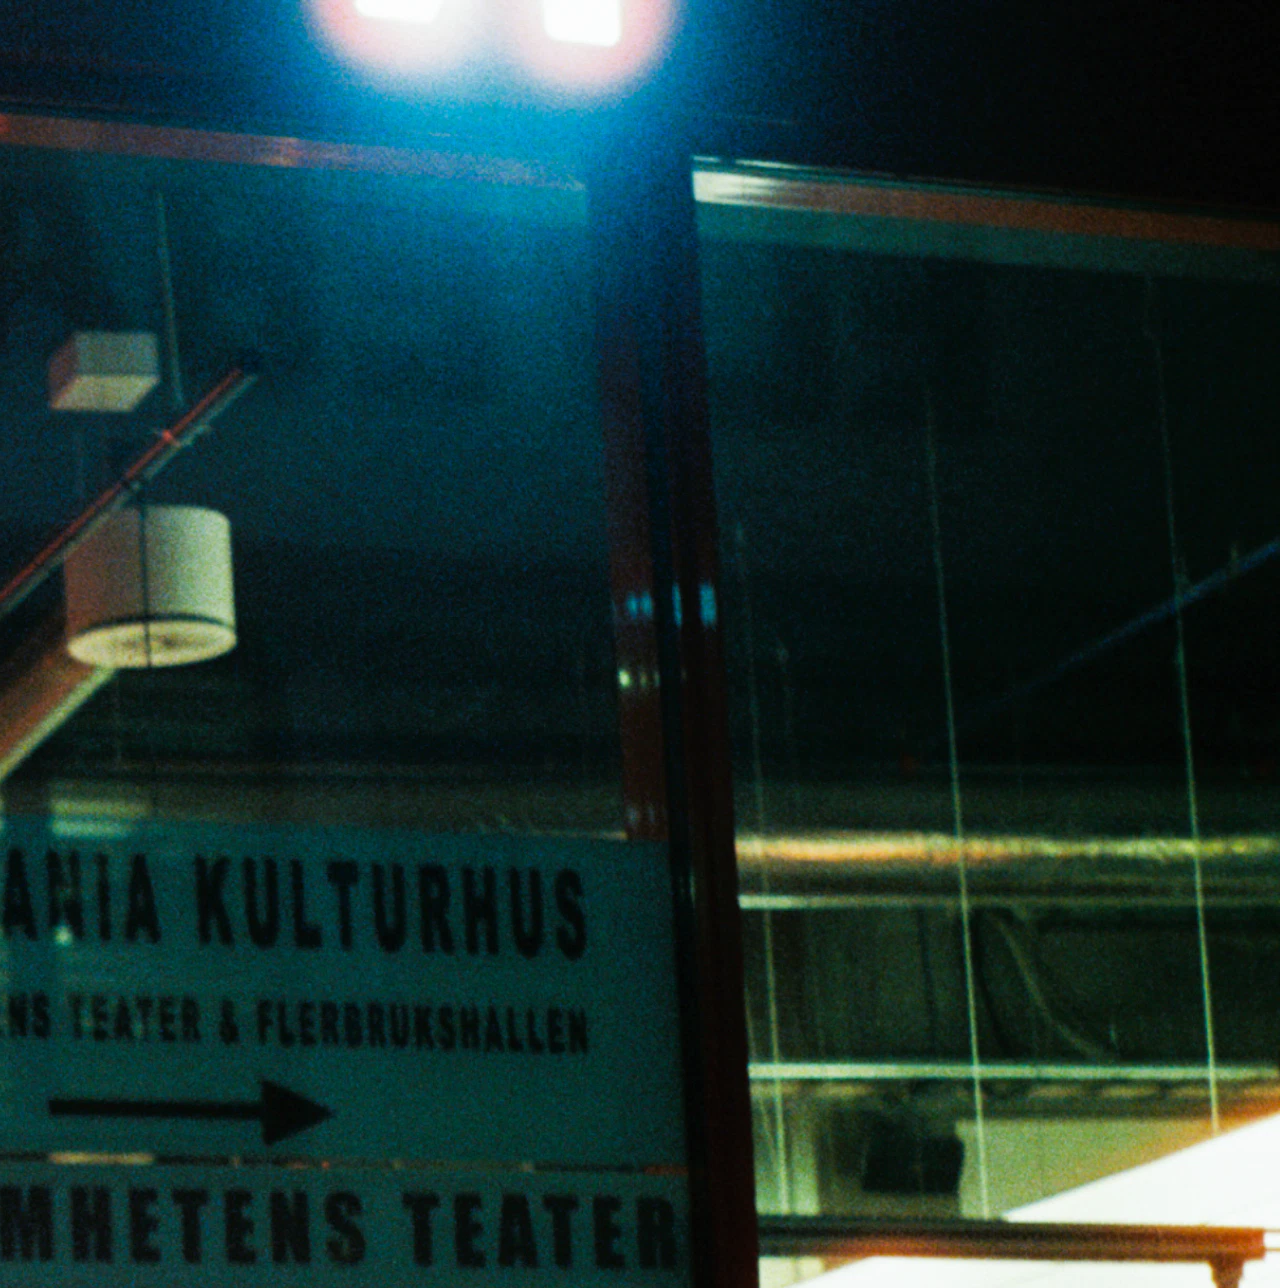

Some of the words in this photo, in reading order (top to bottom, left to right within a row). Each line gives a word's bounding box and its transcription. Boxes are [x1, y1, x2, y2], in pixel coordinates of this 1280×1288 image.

[195, 853, 588, 961] KULTURHUS
[67, 993, 202, 1043] TEATER
[256, 1000, 590, 1055] FLERBRUKSHALLEN
[402, 1189, 678, 1269] TEATER
